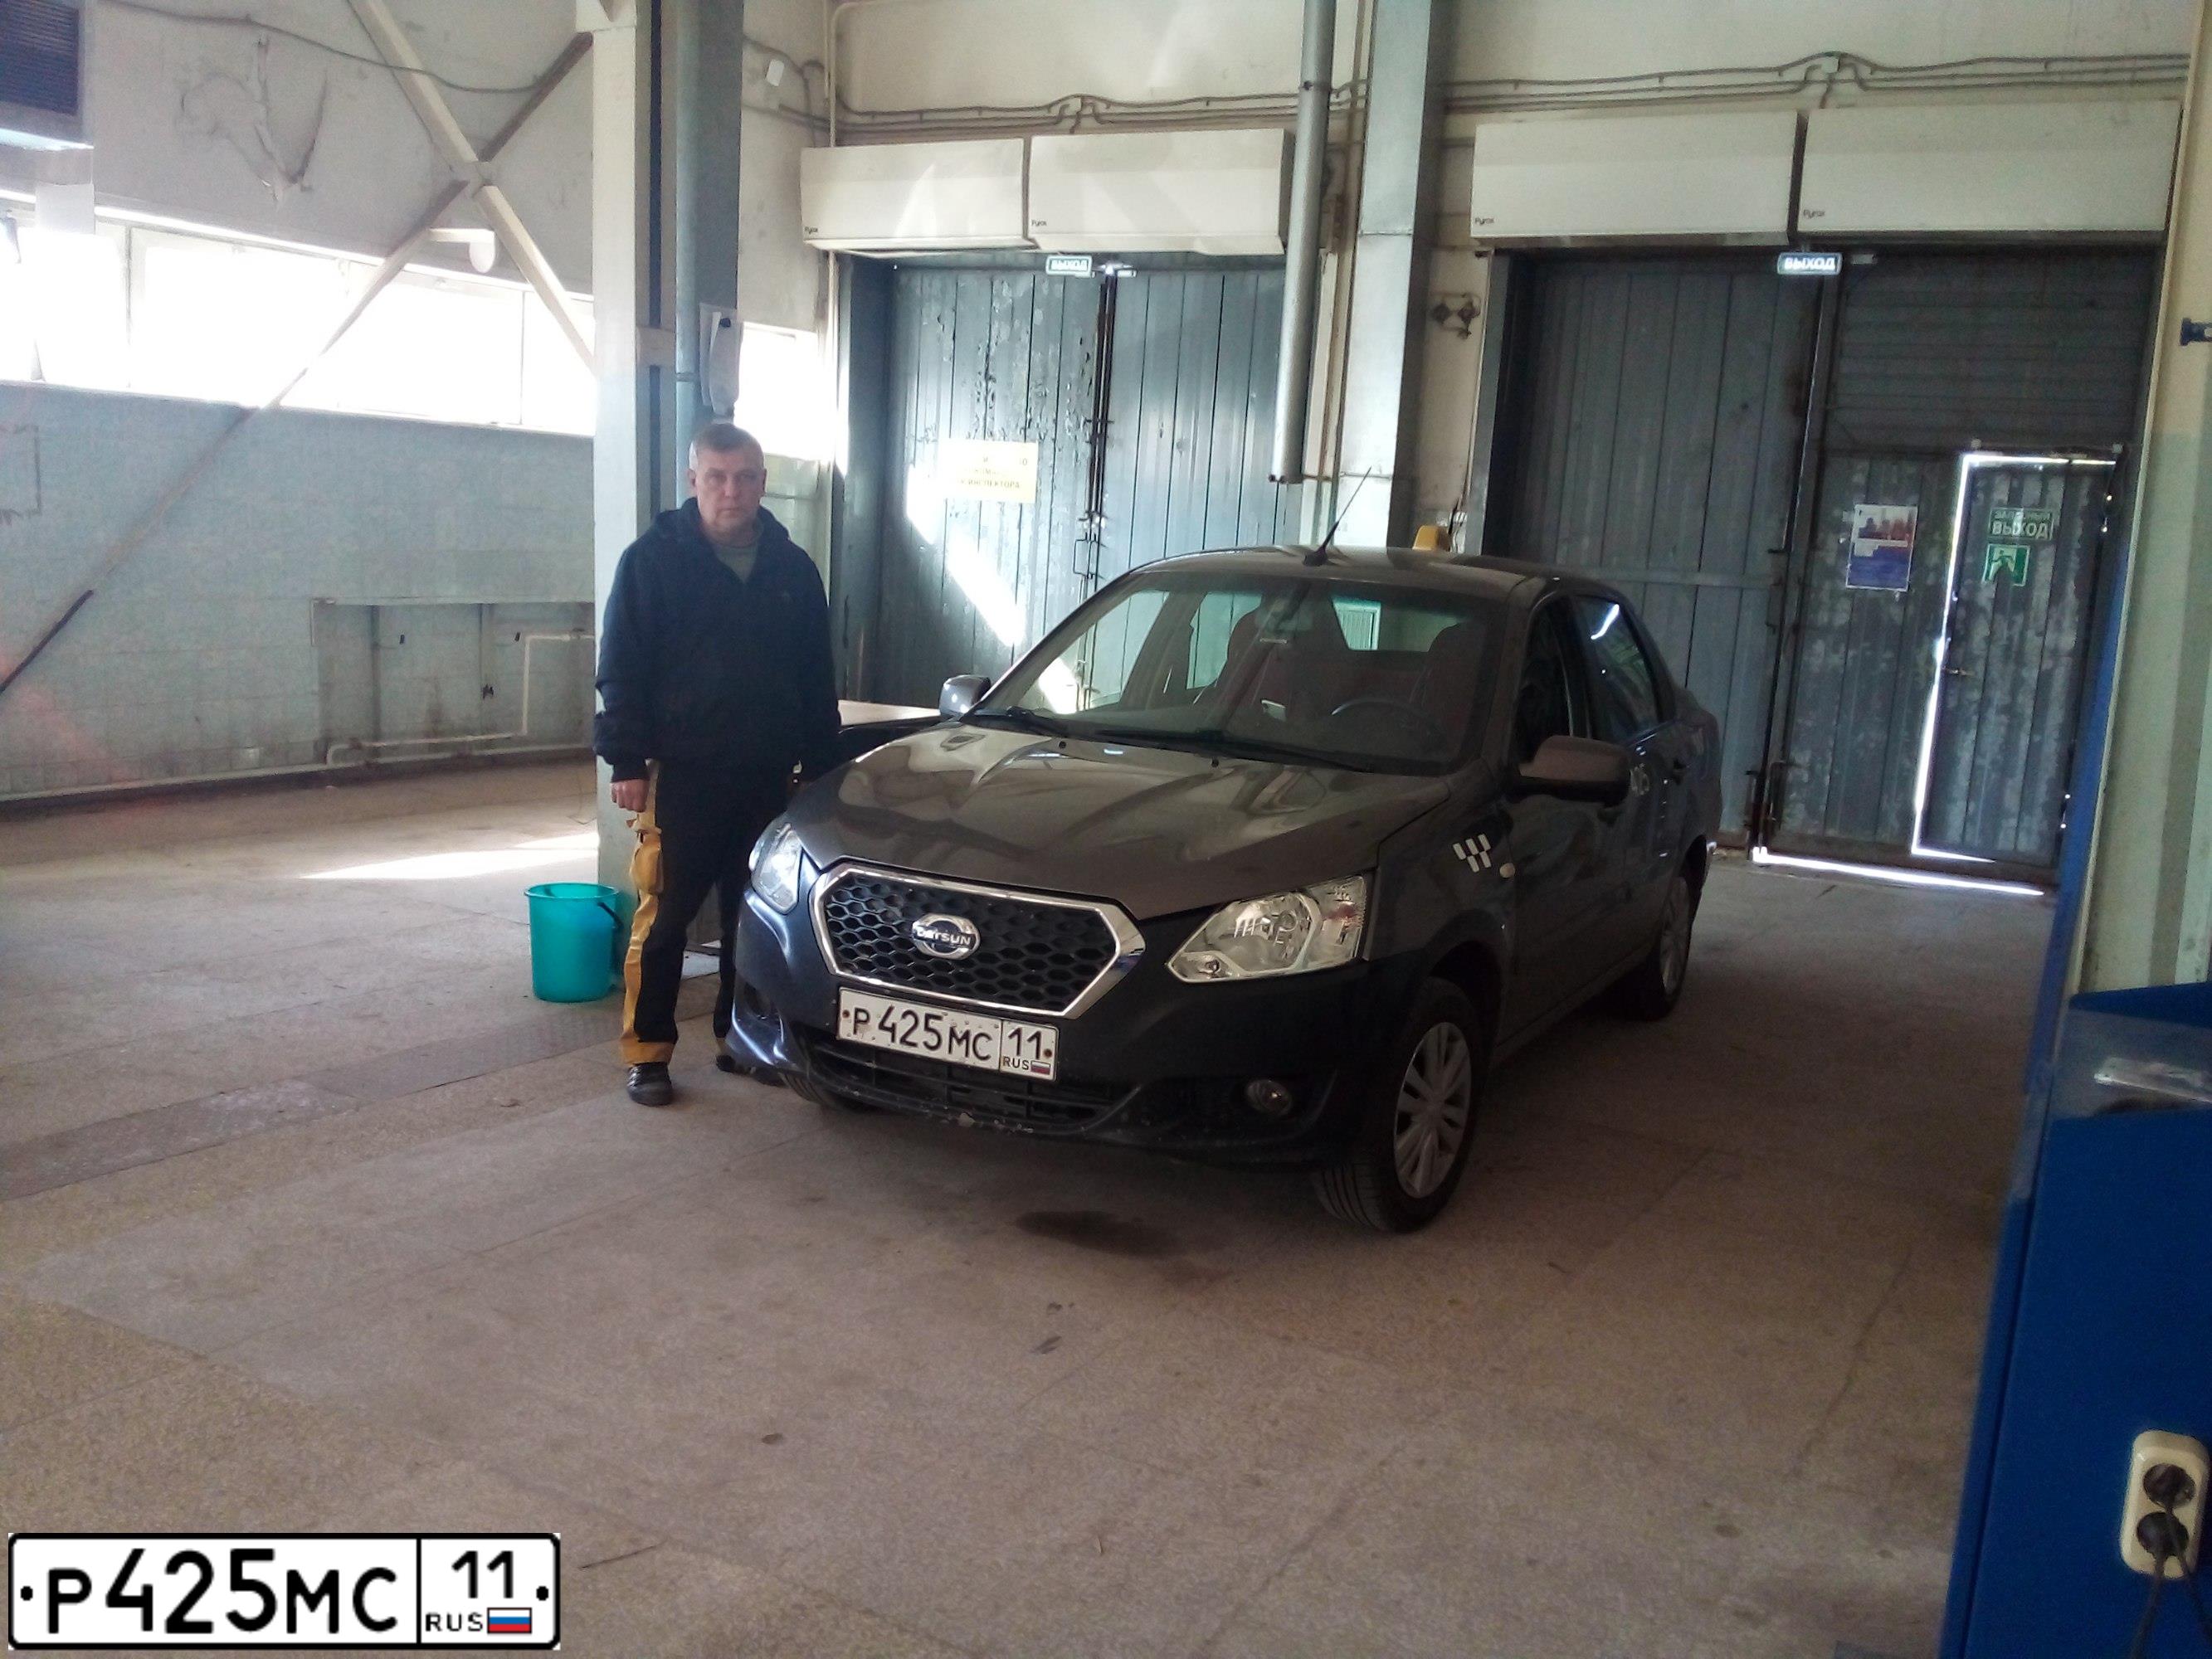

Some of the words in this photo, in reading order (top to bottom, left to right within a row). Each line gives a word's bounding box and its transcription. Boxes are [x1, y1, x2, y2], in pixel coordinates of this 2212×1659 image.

[1784, 257, 1835, 270] ВЫХОД
[1992, 520, 2049, 539] ВЫХОД
[852, 1005, 992, 1061] Р425МС
[1008, 1027, 1042, 1060] 11
[1002, 1056, 1030, 1071] RUS
